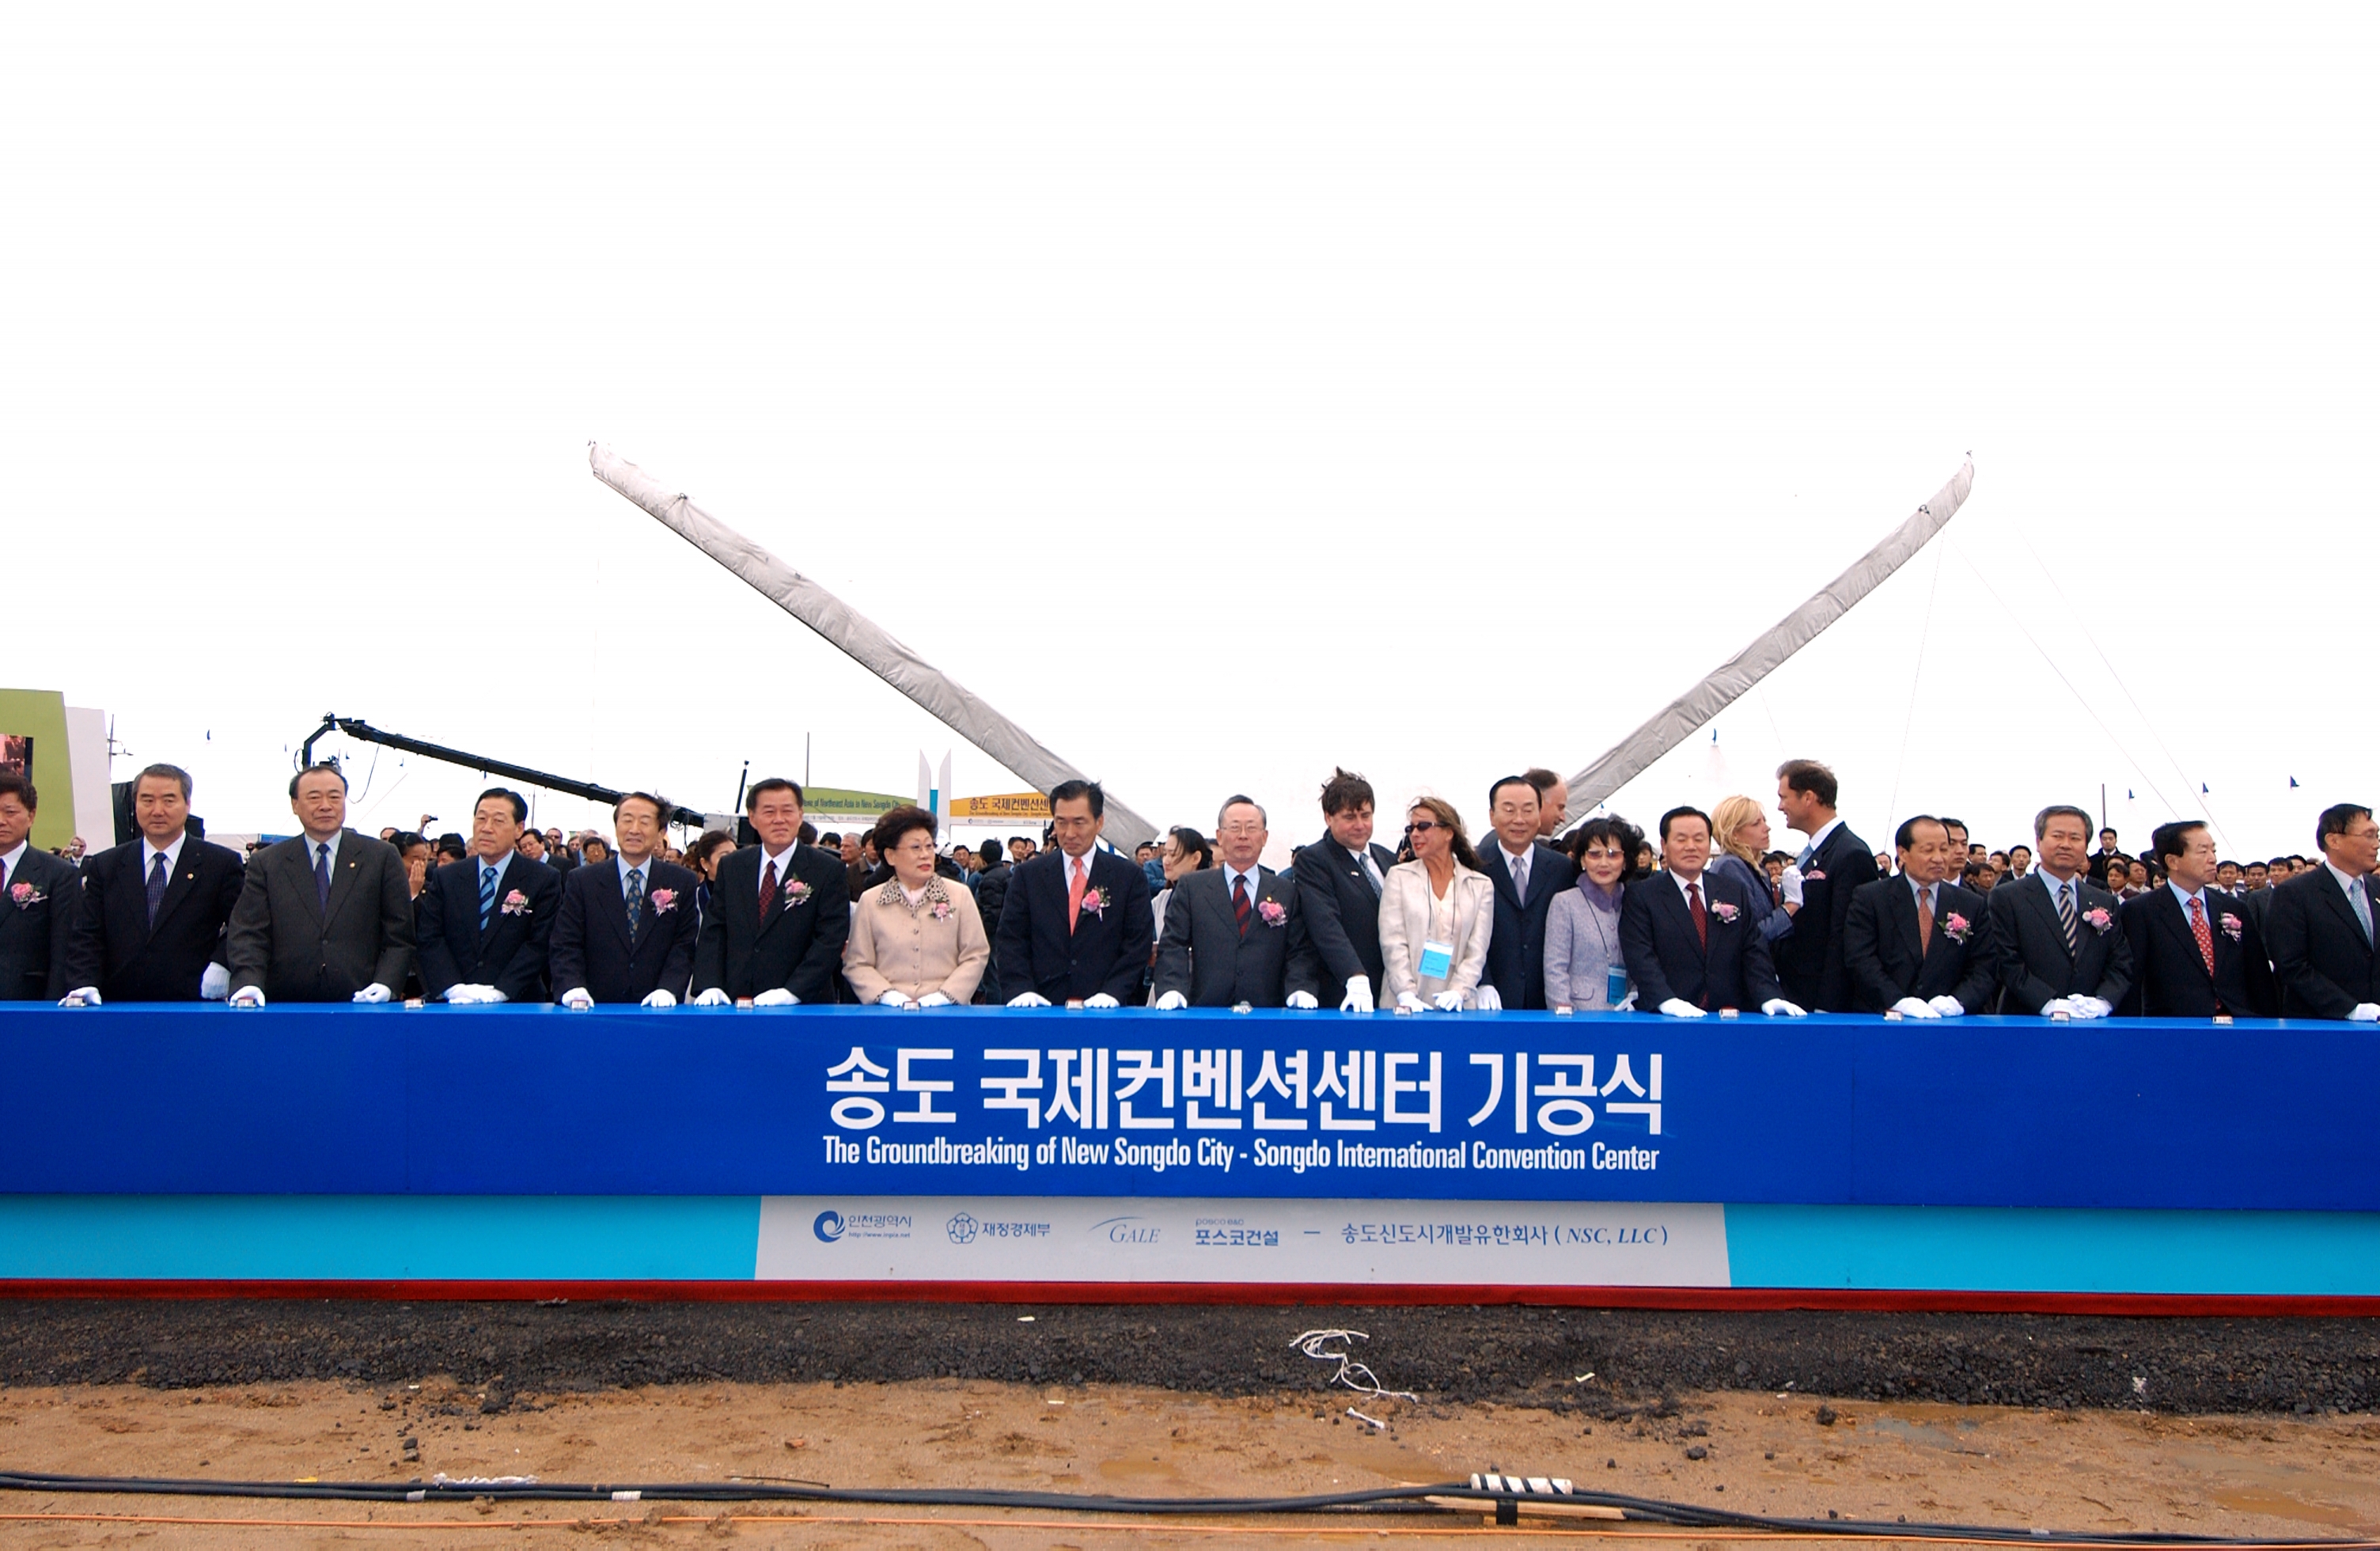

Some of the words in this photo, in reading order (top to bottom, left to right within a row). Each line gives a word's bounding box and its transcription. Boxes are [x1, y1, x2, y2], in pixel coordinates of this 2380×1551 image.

[970, 798, 988, 810] 송도
[992, 798, 1049, 811] 국제컨벤션센
[825, 1047, 957, 1129] 송도
[981, 1049, 1442, 1132] 국제컨벤션센터
[1469, 1052, 1662, 1136] 기공식
[823, 1136, 859, 1163] The
[867, 1136, 1029, 1170] Groundbreaking
[1037, 1136, 1056, 1164] of
[1063, 1137, 1109, 1164] New
[1115, 1137, 1190, 1172] Songdo
[1198, 1138, 1234, 1172] City
[1254, 1139, 1330, 1173] Songdo
[1338, 1140, 1465, 1168] International
[1473, 1141, 1585, 1169] Convention
[1593, 1142, 1660, 1170] Center
[848, 1215, 911, 1229] 인천광역시
[982, 1223, 1051, 1238] 재정경제부
[1109, 1224, 1161, 1243] GALE
[1196, 1229, 1279, 1247] 포스코건설
[1341, 1223, 1548, 1246] 송도신도시개발유한회사
